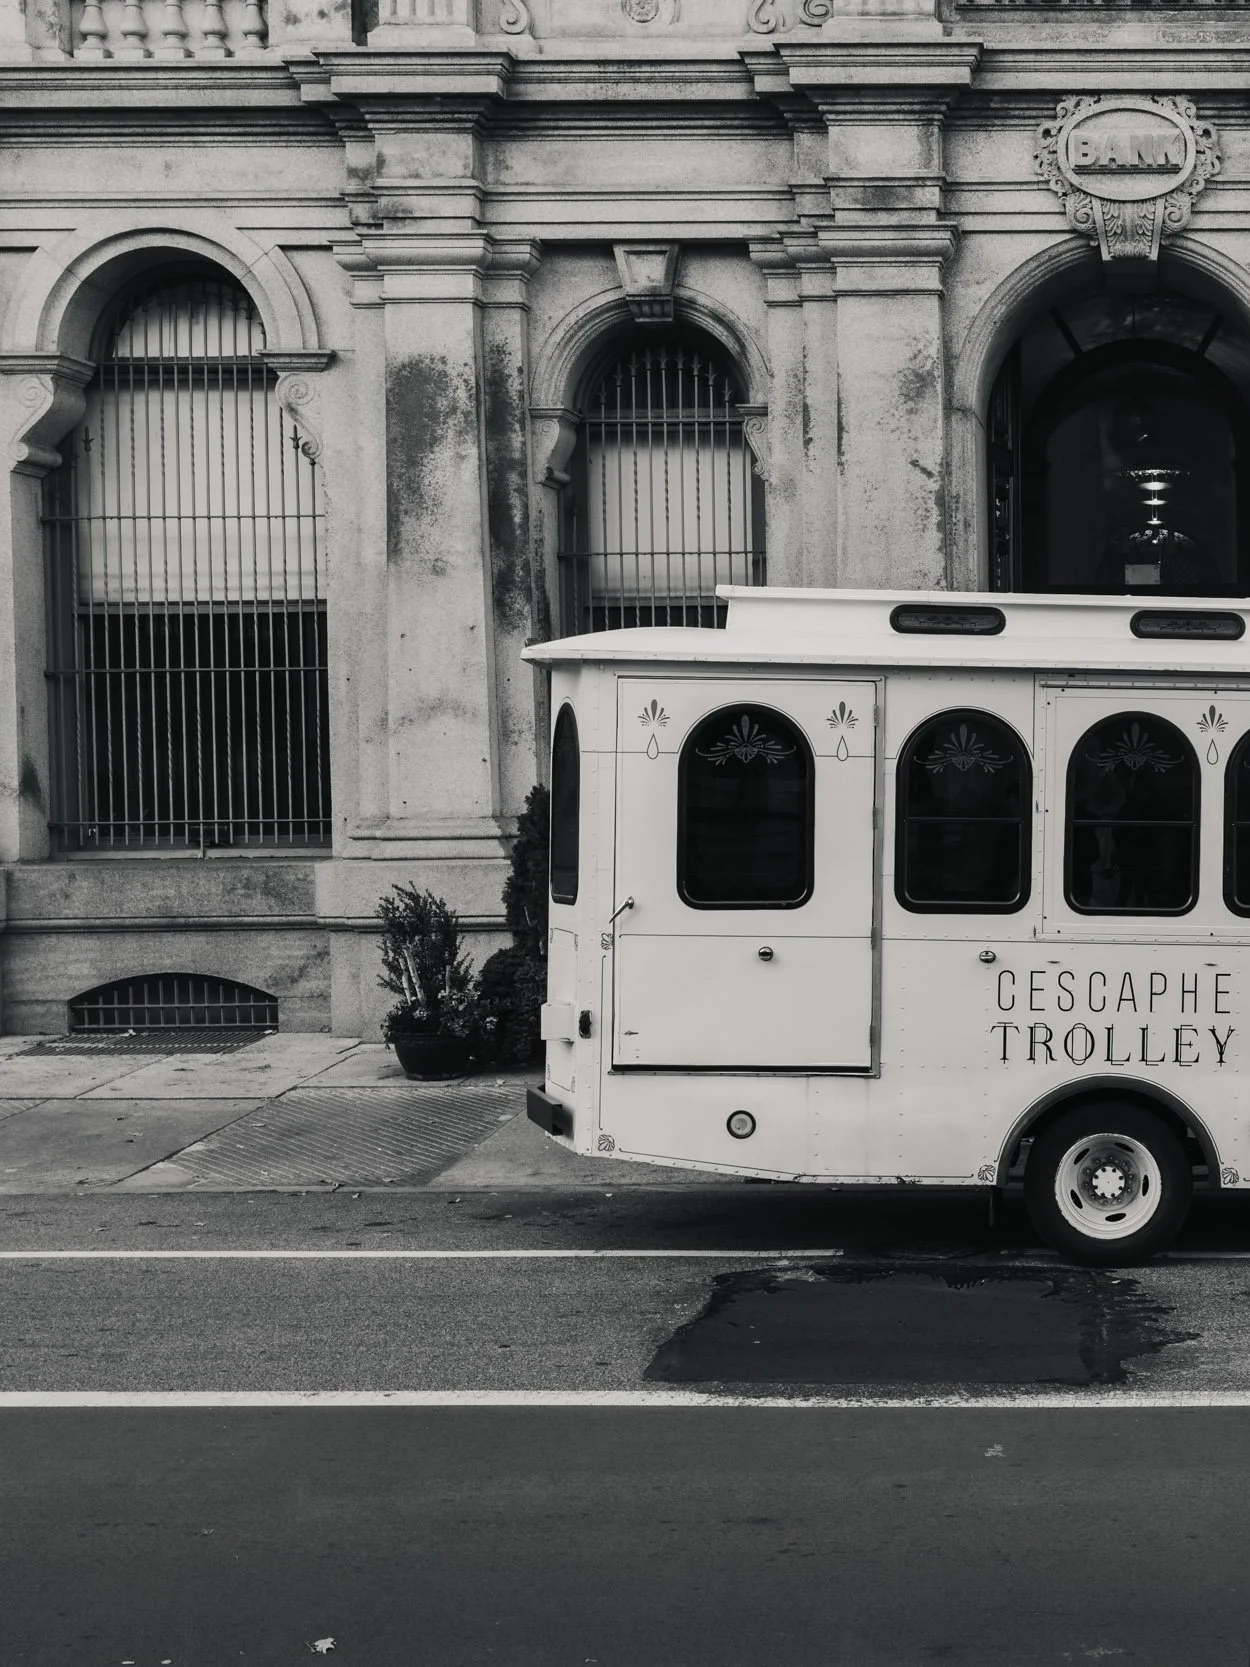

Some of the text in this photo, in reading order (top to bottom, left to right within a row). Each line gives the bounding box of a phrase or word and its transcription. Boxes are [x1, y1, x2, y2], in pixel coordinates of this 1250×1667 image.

[1073, 133, 1180, 168] BANK
[998, 970, 1231, 1014] CESCAPHE
[990, 1021, 1236, 1067] TROLLEY
